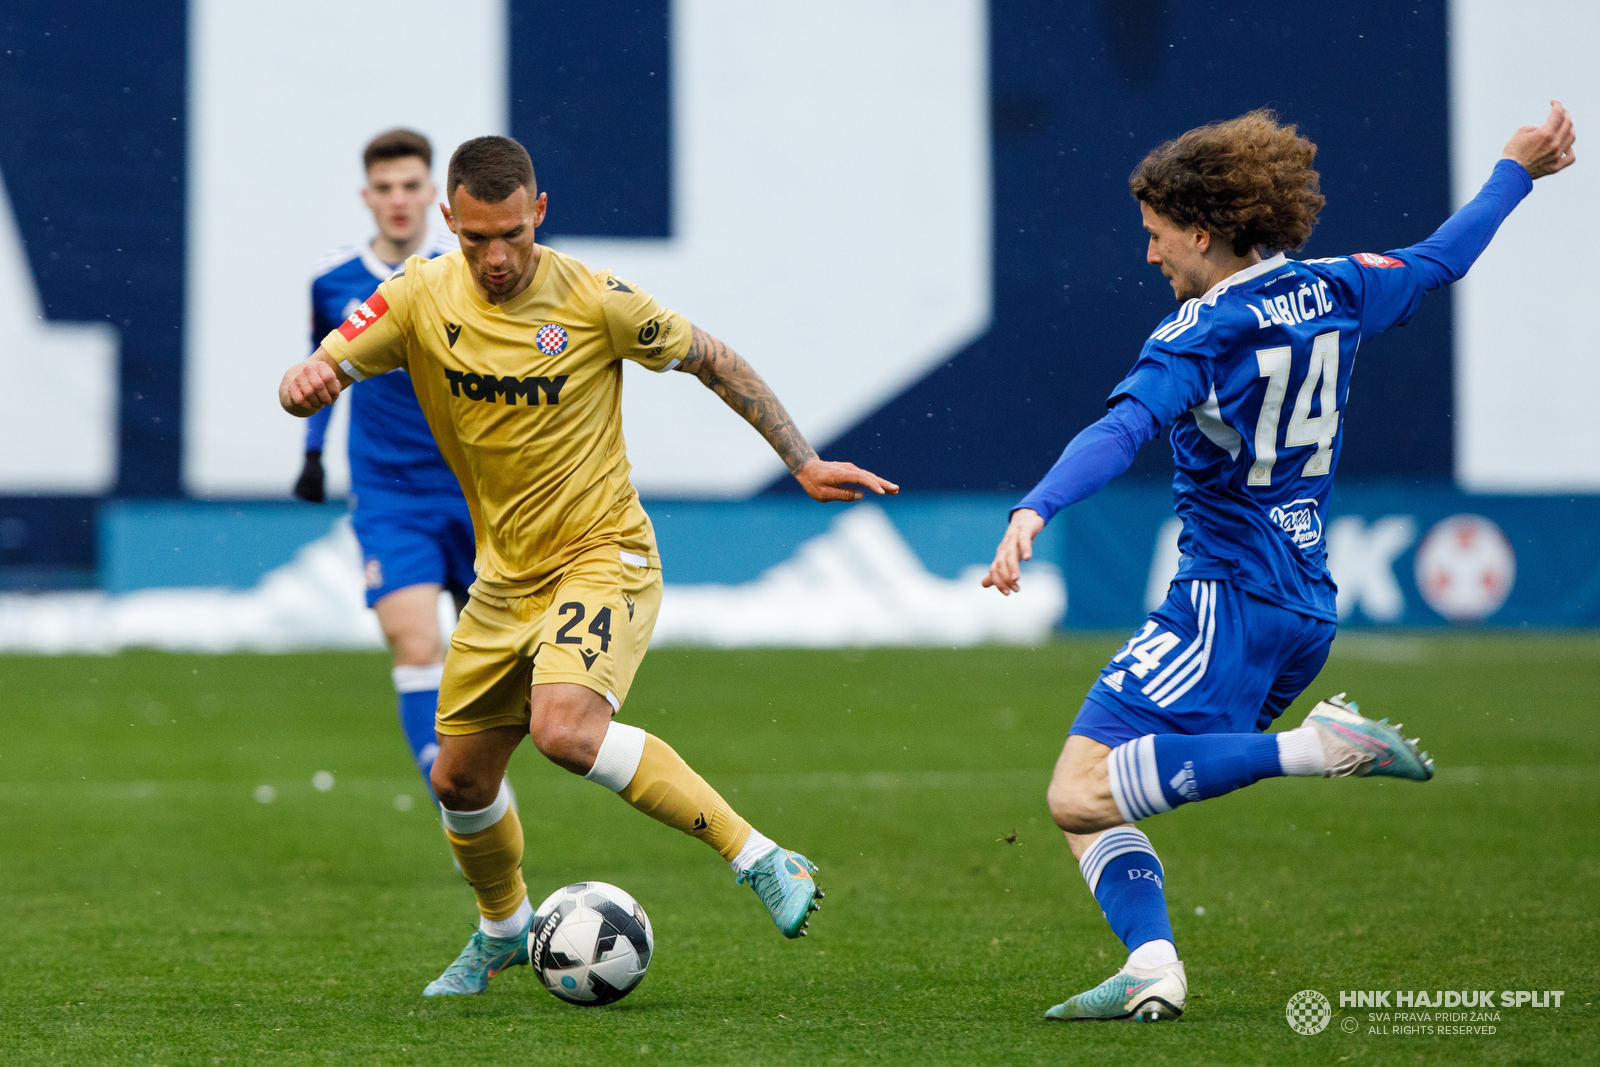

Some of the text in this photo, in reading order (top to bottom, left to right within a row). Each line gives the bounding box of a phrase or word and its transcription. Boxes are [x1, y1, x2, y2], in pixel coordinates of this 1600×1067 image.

[444, 367, 570, 406] TOMMY
[1247, 330, 1340, 486] 14
[555, 601, 612, 654] 24
[1112, 620, 1181, 679] 14
